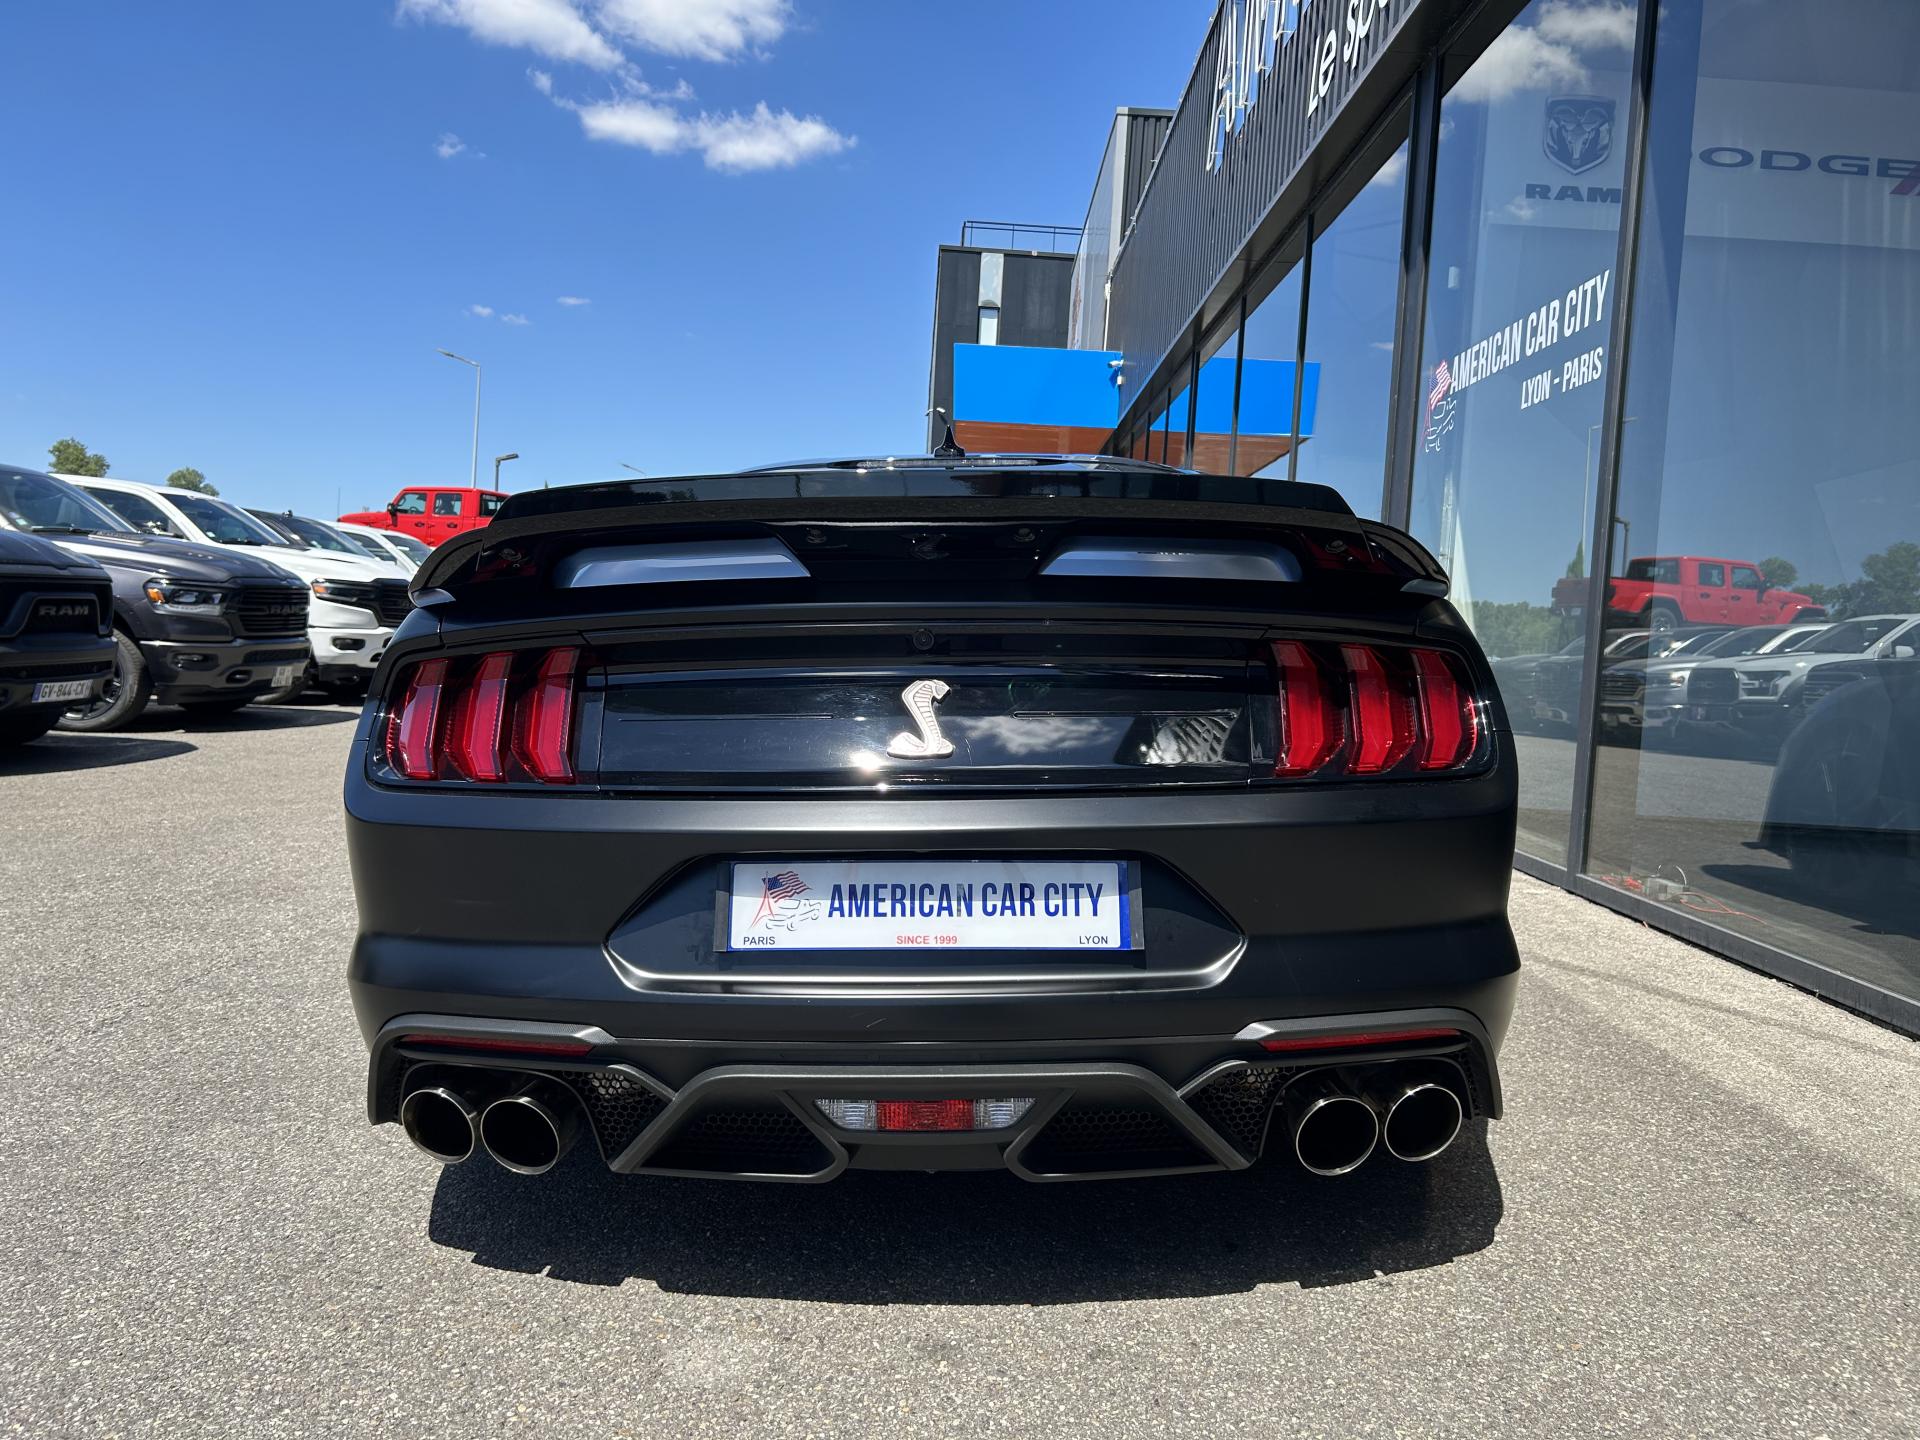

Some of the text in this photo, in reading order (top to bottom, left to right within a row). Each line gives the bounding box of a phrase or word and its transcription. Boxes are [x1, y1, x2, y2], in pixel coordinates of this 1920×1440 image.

[1307, 29, 1337, 118] Le
[1343, 0, 1388, 70] sp
[1690, 147, 1920, 178] ODGE
[1525, 183, 1622, 204] RAM
[1450, 269, 1610, 395] AMERICAN CAR CITY
[1520, 369, 1551, 410] LYON
[1562, 346, 1603, 393] PARIS
[39, 605, 89, 616] RAM
[828, 882, 1104, 918] AMERICAN CAR CITY
[743, 935, 776, 946] PARIS
[896, 935, 958, 946] SINCE 1999
[1079, 935, 1109, 946] LYON
